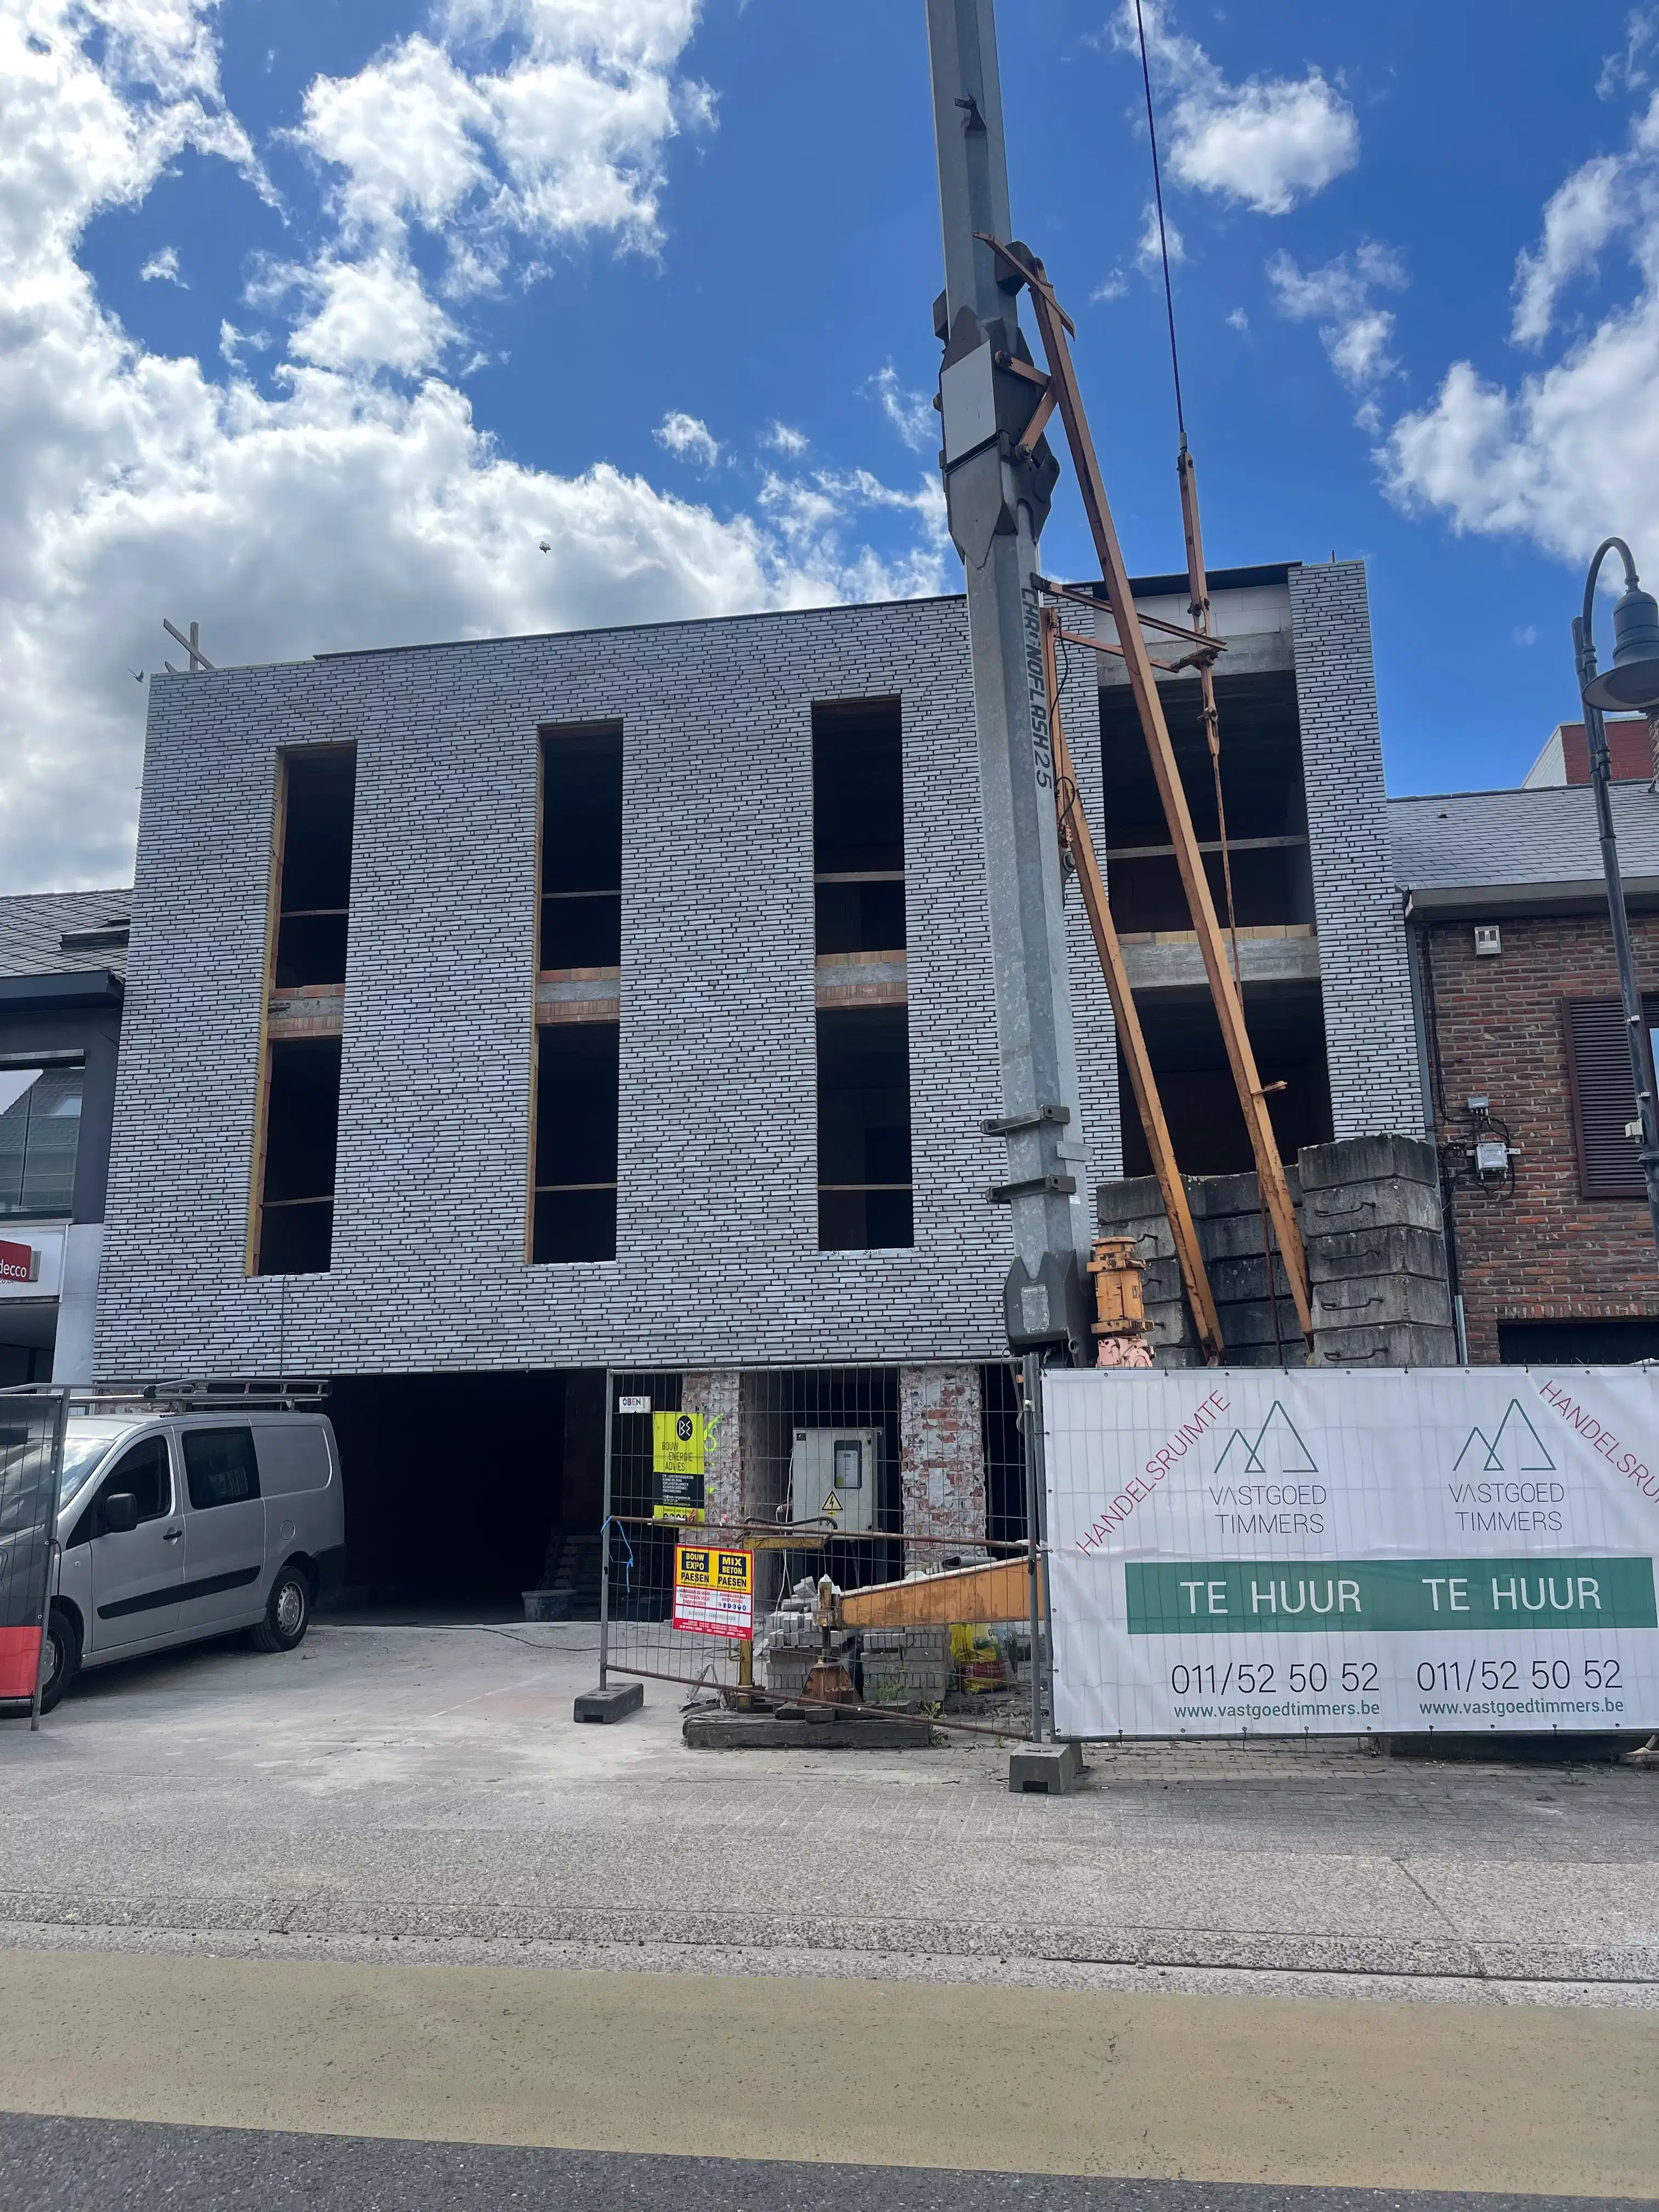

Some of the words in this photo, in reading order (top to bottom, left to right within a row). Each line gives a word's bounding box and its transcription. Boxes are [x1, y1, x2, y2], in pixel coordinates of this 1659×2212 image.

[623, 1397, 641, 1406] OBEN
[662, 1442, 679, 1451] BOUW
[665, 1462, 685, 1471] ADVIES
[669, 1452, 693, 1462] ENERGIE
[1076, 1390, 1231, 1556] HANDELSRUIMTE
[1209, 1485, 1327, 1505] VASTGOED
[1448, 1483, 1565, 1503] VASTGOED
[1215, 1514, 1324, 1534] TIMMERS
[1455, 1511, 1562, 1531] TIMMERS
[686, 1553, 704, 1561] BOUW
[686, 1561, 704, 1571] EXPO
[722, 1557, 742, 1566] MIX
[681, 1572, 709, 1583] PAESEN
[722, 1566, 742, 1575] BETON
[718, 1576, 746, 1588] PAESEN
[1180, 1581, 1229, 1614] TE
[1251, 1580, 1362, 1613] HUUR
[1421, 1578, 1470, 1611] TE
[1492, 1577, 1602, 1610] HUUR
[1172, 1662, 1277, 1695] 011/52
[1289, 1662, 1327, 1692] 50
[1341, 1662, 1380, 1692] 52
[1417, 1660, 1519, 1692] 011/52
[1532, 1660, 1570, 1689] 50
[1584, 1659, 1623, 1689] 52
[1173, 1700, 1380, 1720] www.vastgoedtimmers.be
[1419, 1697, 1624, 1718] www.vastgoedtimmers.be
